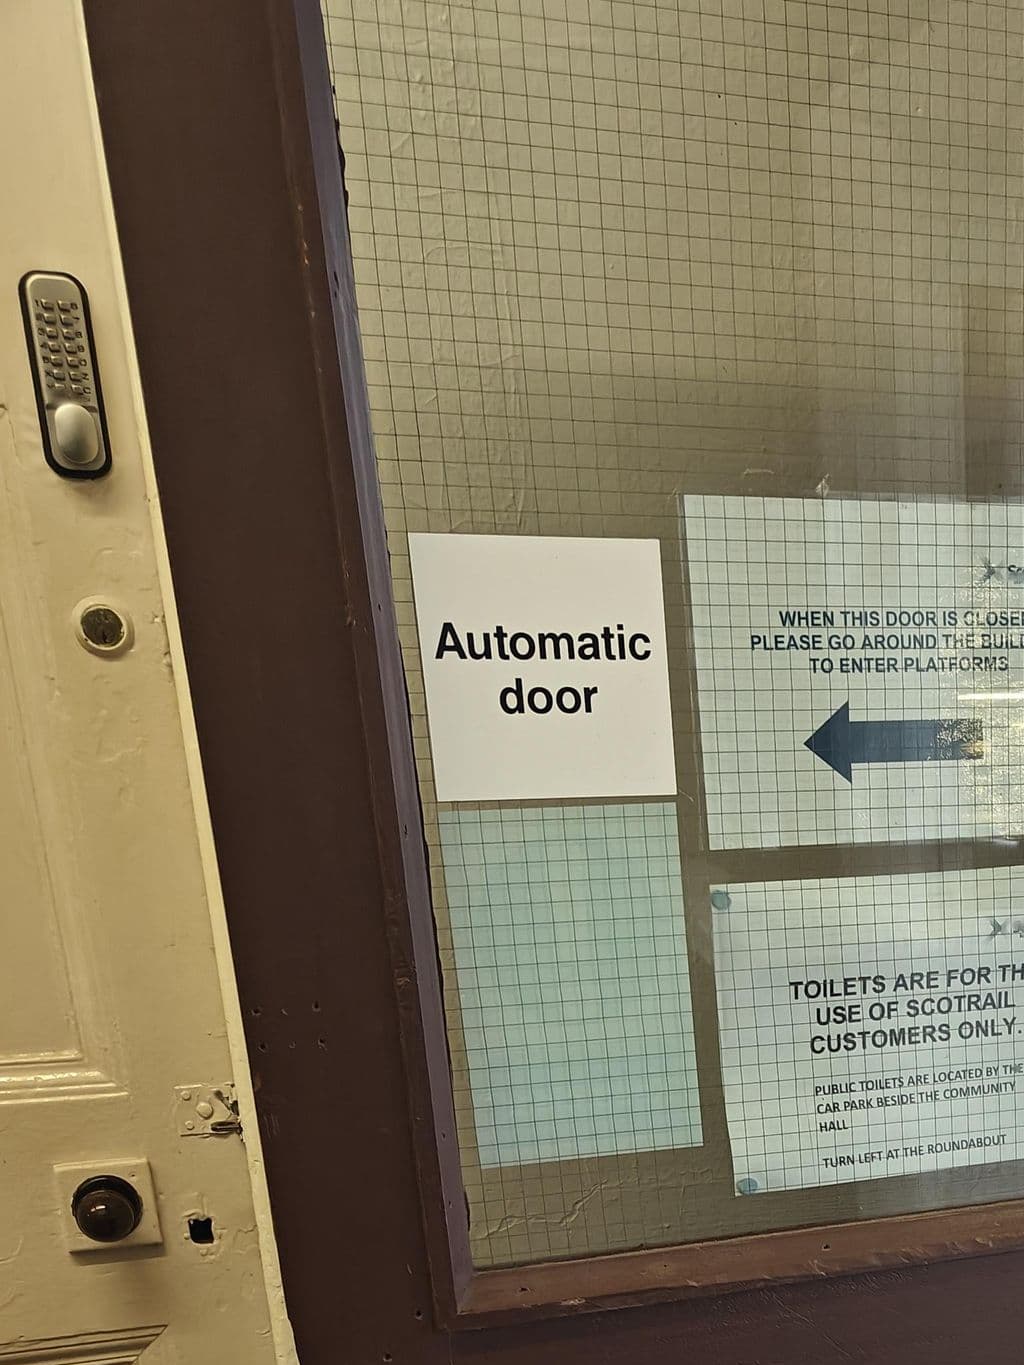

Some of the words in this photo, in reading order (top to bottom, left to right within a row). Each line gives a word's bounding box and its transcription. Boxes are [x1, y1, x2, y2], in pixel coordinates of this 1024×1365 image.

[779, 611, 834, 627] WHEN
[840, 611, 880, 626] THIS
[886, 611, 937, 626] DOOR
[943, 612, 957, 625] IS
[435, 621, 652, 662] Automatic
[751, 635, 822, 650] PLEASE
[828, 635, 855, 650] GO
[861, 634, 937, 649] AROUND
[943, 634, 975, 649] THE
[810, 658, 833, 673] TO
[840, 657, 898, 673] ENTER
[904, 656, 1009, 672] PLATFORMS
[499, 677, 598, 715] door
[789, 975, 885, 1000] TOILETS
[893, 971, 939, 992] ARE
[947, 967, 991, 987] FOR
[816, 1005, 861, 1025] USE
[869, 1001, 898, 1021] OF
[907, 991, 1015, 1017] SCOTRAIL
[810, 1024, 950, 1054] CUSTOMERS
[958, 1017, 1022, 1039] ONLY.
[815, 1082, 856, 1096] PUBLIC
[859, 1076, 904, 1092] TOILETS
[908, 1075, 929, 1087] ARE
[933, 1069, 983, 1083] LOCATED
[986, 1067, 999, 1076] BY
[1003, 1063, 1024, 1075] THE
[817, 1101, 841, 1114] CAR
[844, 1098, 873, 1111] PARK
[877, 1094, 916, 1108] BESIDE
[919, 1090, 940, 1102] THE
[943, 1082, 1016, 1099] COMMUNITY
[820, 1120, 848, 1133] HALL
[823, 1156, 855, 1168] TURN
[859, 1151, 883, 1164] LEFT
[886, 1148, 899, 1160] AT
[903, 1145, 925, 1157] THE
[928, 1135, 1007, 1154] ROUNDABOUT
